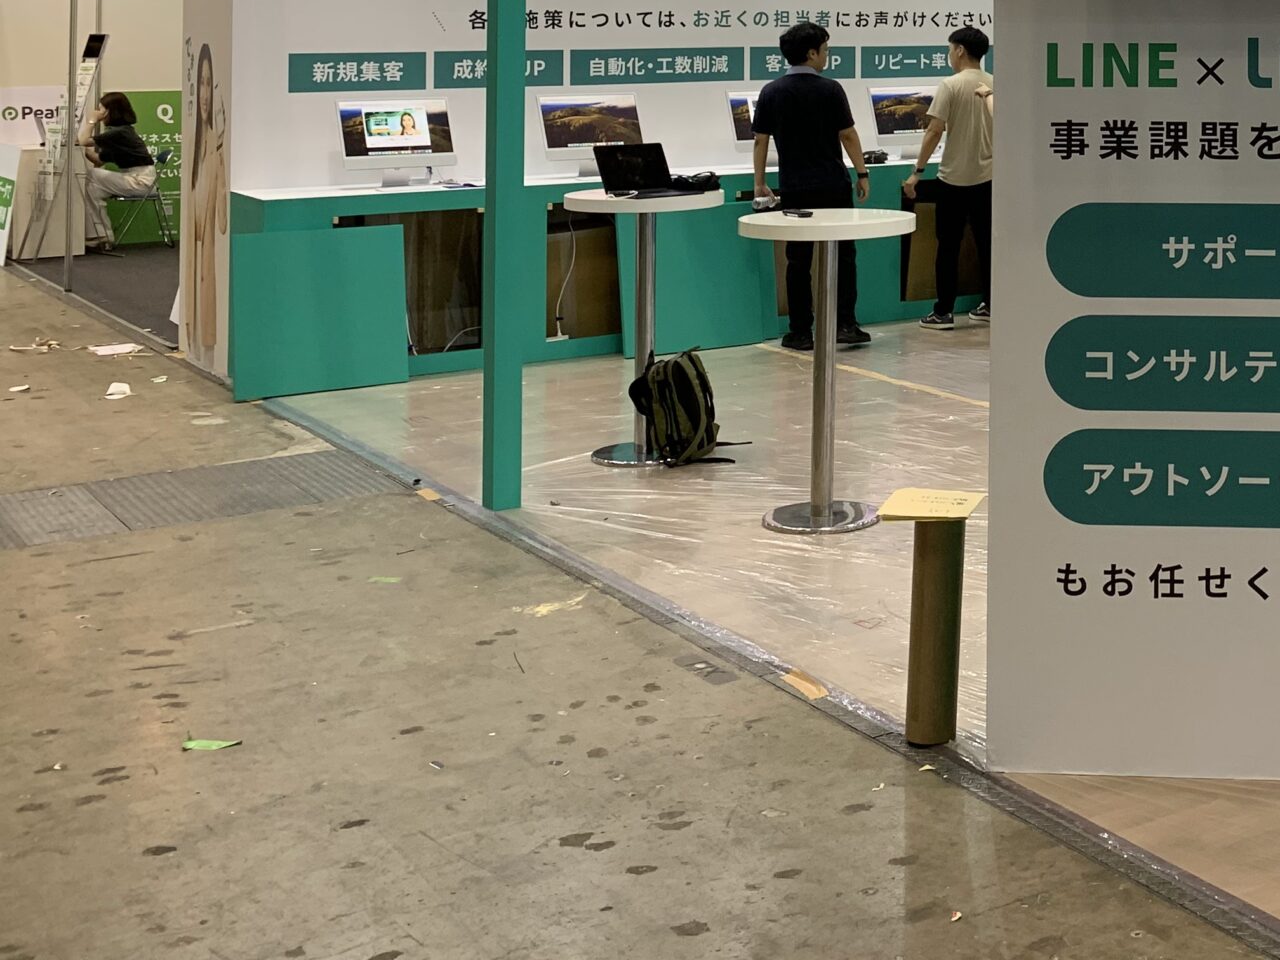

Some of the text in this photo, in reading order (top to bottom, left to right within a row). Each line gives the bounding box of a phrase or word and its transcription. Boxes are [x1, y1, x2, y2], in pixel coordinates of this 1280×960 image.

[312, 60, 404, 83] 新規集客
[588, 54, 729, 78] 自動化・工数削減
[1045, 41, 1178, 88] LINE
